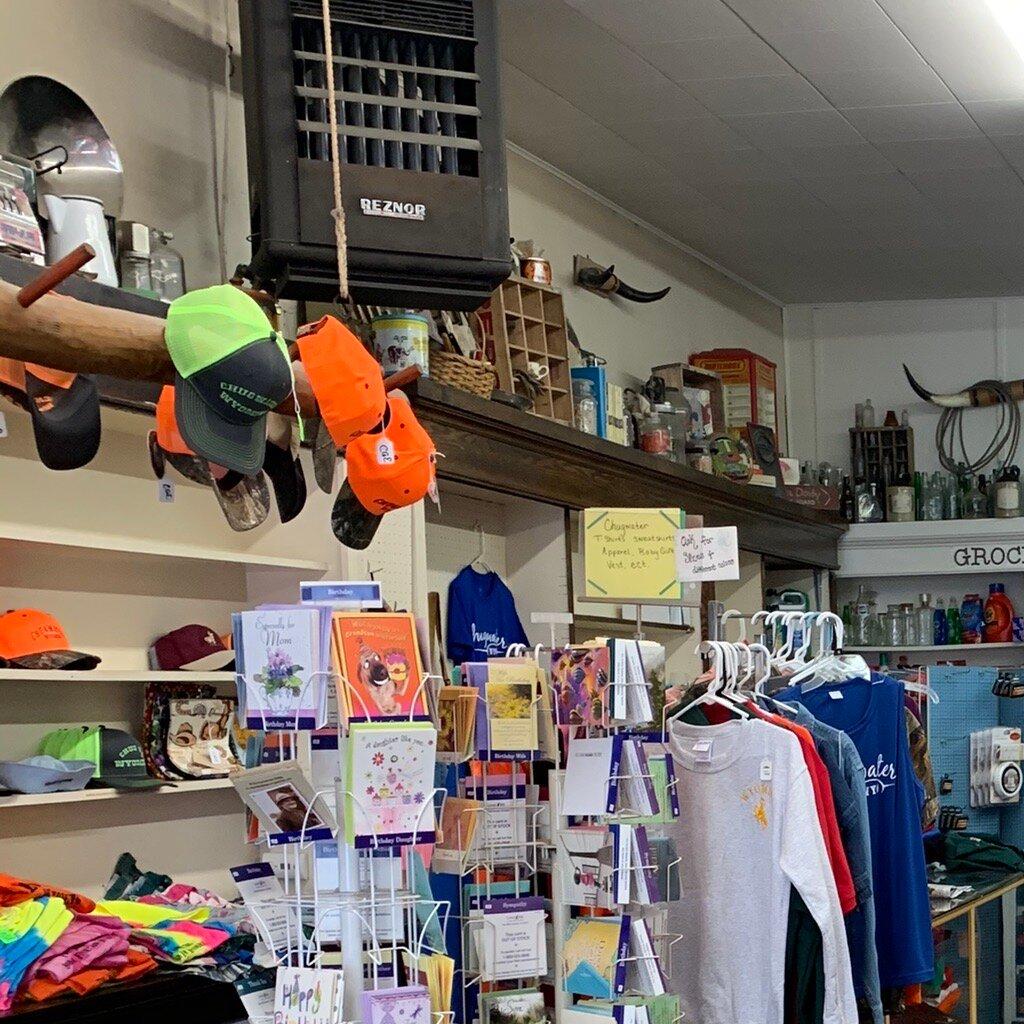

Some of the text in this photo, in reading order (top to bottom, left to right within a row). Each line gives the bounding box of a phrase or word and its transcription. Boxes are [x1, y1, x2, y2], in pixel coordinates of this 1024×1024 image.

[360, 198, 426, 216] REZNOR
[603, 518, 649, 536] Chugwater
[260, 631, 293, 647] Mom
[494, 752, 517, 761] Birthday
[282, 974, 322, 1014] Happy
